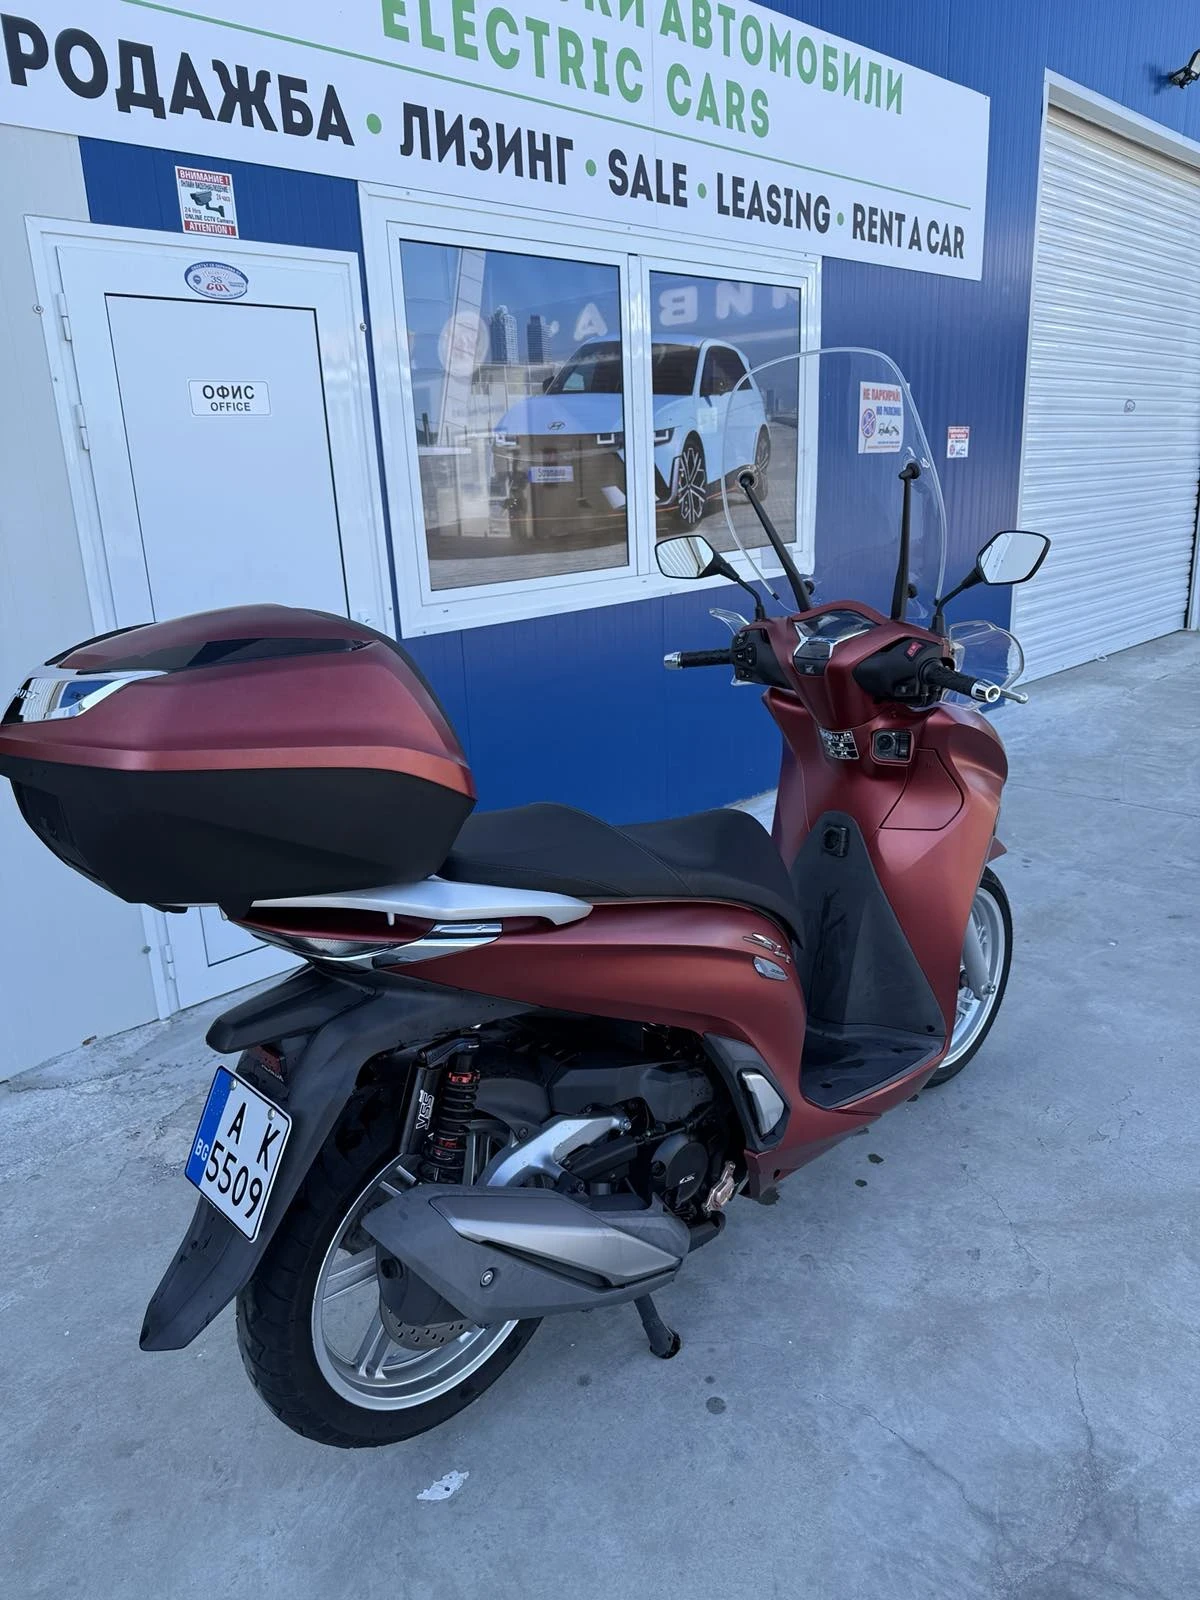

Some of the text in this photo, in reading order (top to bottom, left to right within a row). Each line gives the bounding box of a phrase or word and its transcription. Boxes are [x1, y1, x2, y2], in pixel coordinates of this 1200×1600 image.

[381, 0, 770, 138] ELECTRIC CARS
[660, 0, 903, 115] АВТОМОБИЛИ
[180, 169, 223, 184] ВНИМАНИЕ
[400, 101, 574, 186] ЛИЗИНГ
[608, 148, 688, 208] SALE
[717, 172, 831, 234] LEASING
[852, 202, 906, 248] RENT
[908, 216, 922, 252] A
[926, 219, 965, 259] CAR
[189, 221, 228, 234] ATTENTION
[202, 384, 255, 400] ОФИС
[210, 402, 251, 412] OFFICE
[195, 1138, 209, 1162] BG
[227, 1102, 281, 1173] A K
[205, 1140, 263, 1219] 5509
